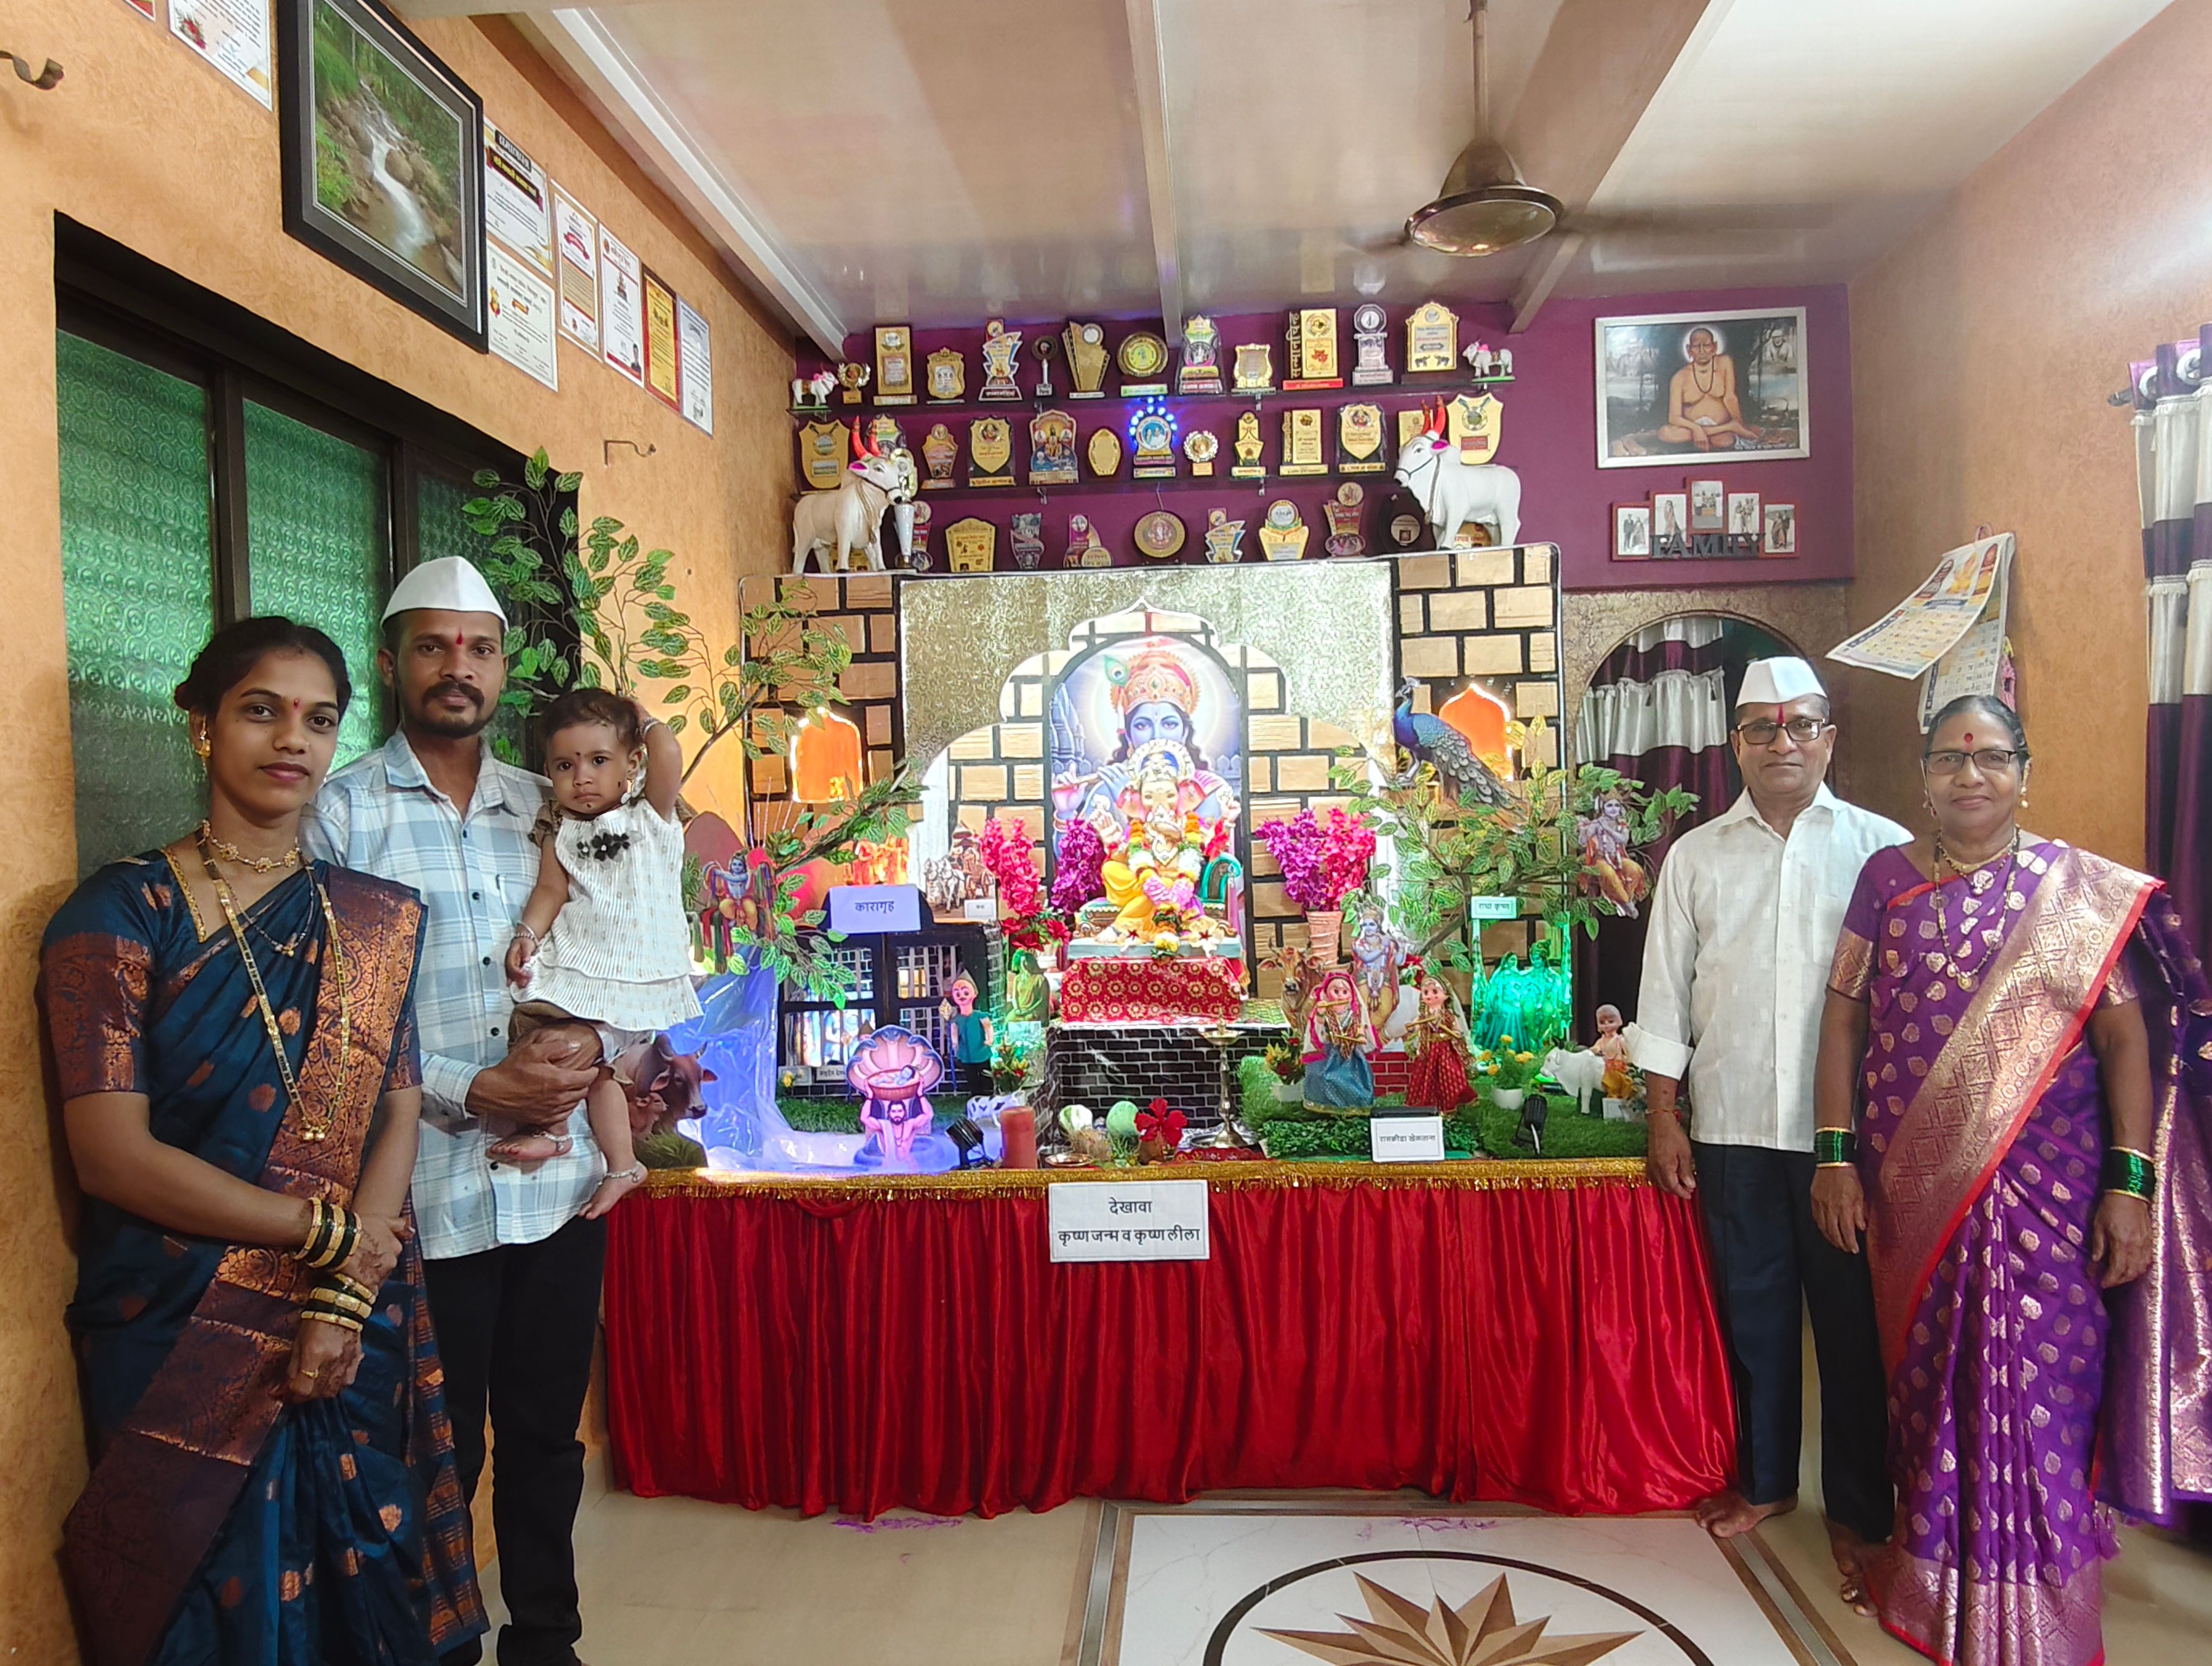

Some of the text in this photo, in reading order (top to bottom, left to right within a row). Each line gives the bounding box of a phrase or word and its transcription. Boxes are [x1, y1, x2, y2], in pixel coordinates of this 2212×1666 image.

[1650, 533, 1766, 559] FAMILY
[854, 900, 895, 913] कारागृह
[1108, 1197, 1153, 1215] देखावा
[1058, 1224, 1200, 1246] कृष्ण जन्म व कृष्ण लीला
